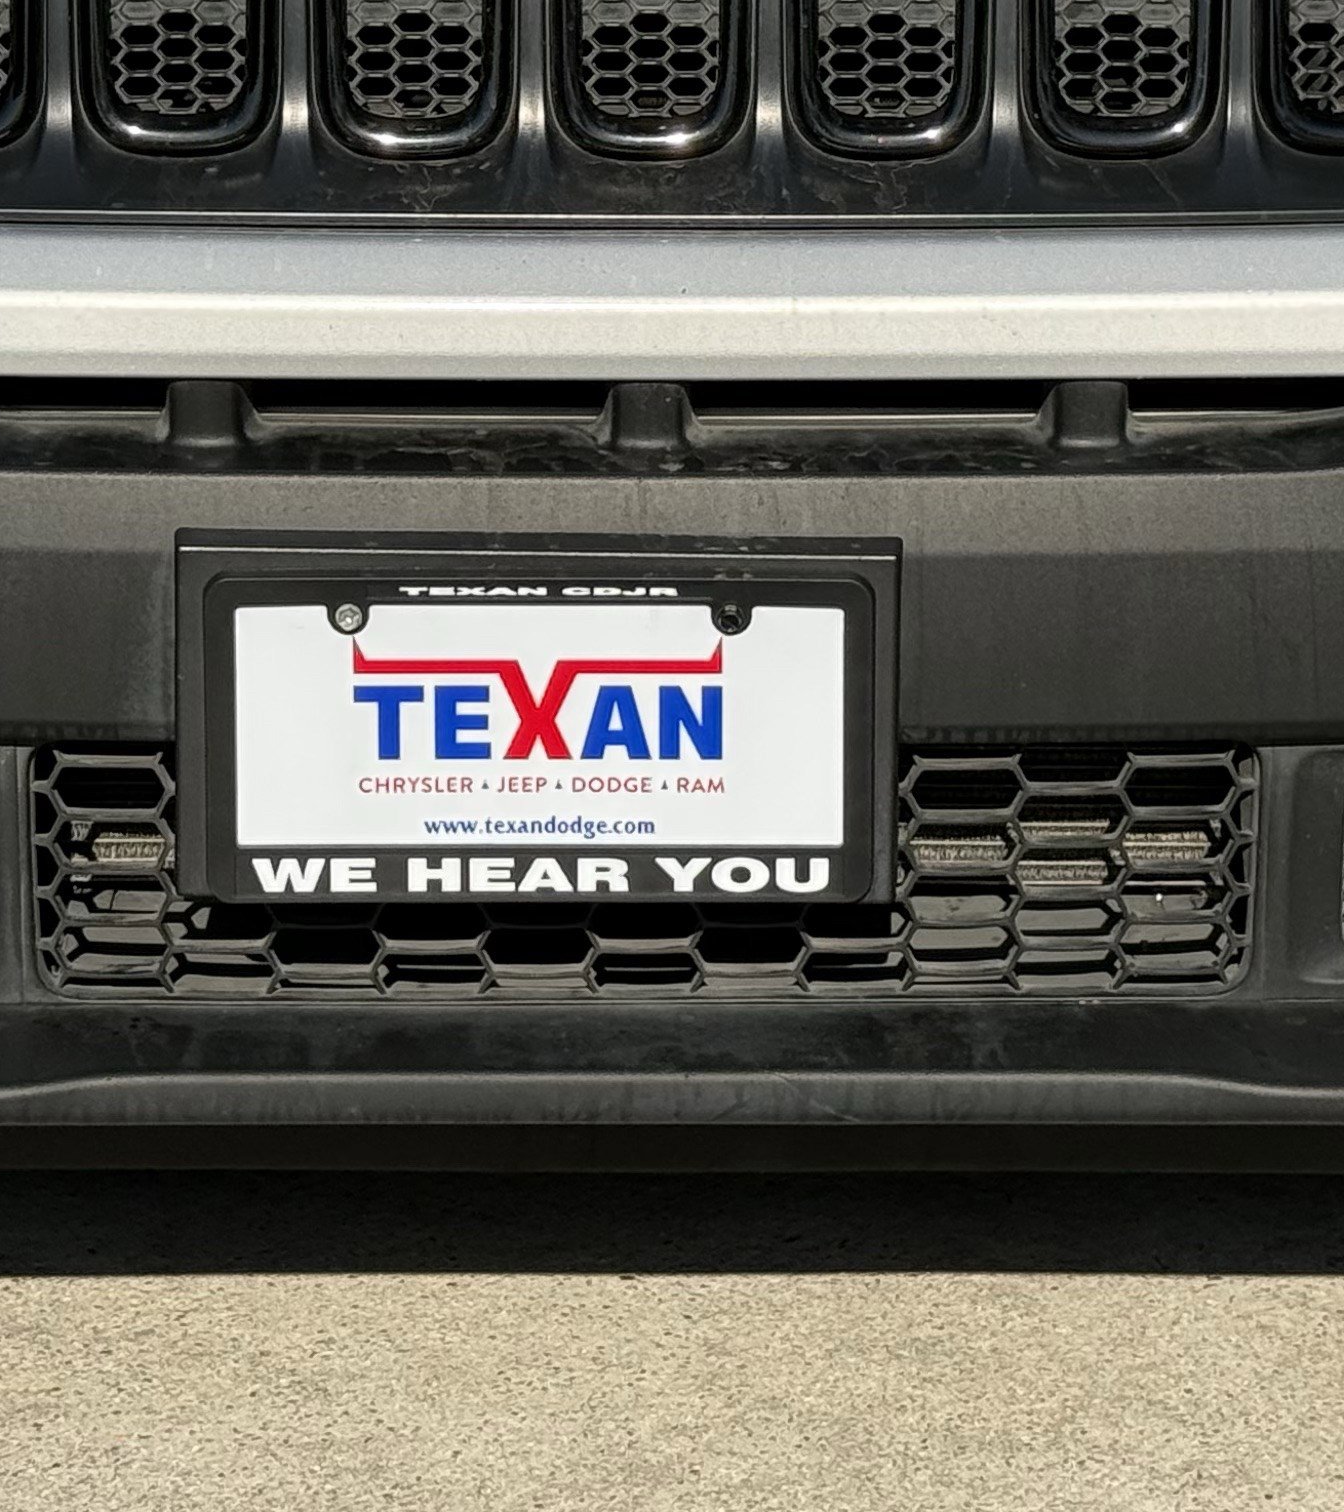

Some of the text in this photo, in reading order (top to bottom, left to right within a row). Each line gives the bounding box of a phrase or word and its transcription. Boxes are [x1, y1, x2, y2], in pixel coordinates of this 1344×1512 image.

[398, 586, 678, 597] TEXAN CDJR
[353, 656, 724, 761] TEXAN
[358, 776, 726, 794] CHRYSLER JEEP DODGE RAM
[424, 815, 655, 840] www.texandodge.com
[251, 856, 830, 894] WE HEAR YOU
